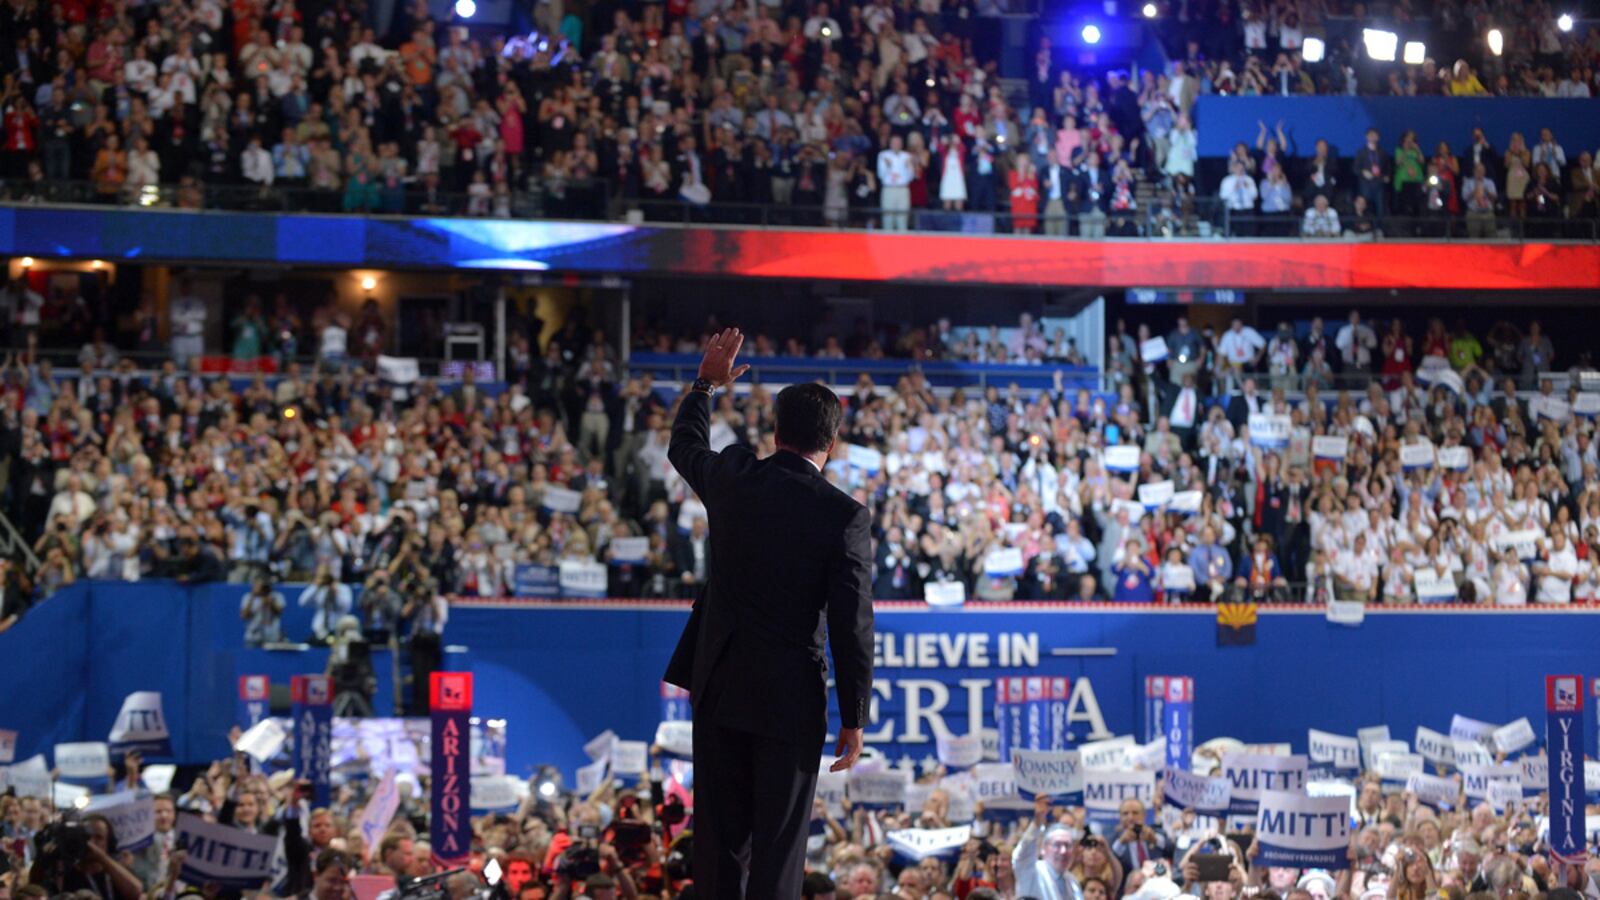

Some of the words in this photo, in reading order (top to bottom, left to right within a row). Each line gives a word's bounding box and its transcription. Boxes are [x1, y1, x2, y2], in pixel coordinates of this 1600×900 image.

[998, 632, 1039, 667] IN
[1014, 753, 1078, 777] ROMNEY
[1226, 767, 1304, 790] MITT!
[441, 717, 461, 852] ARIZONA
[1031, 775, 1071, 790] RYAN
[1086, 783, 1151, 800] MITT!
[1166, 769, 1225, 797] ROMNEY
[1558, 717, 1576, 849] VIRGINIA
[1260, 808, 1346, 837] MITT!
[179, 830, 271, 871] MITT!
